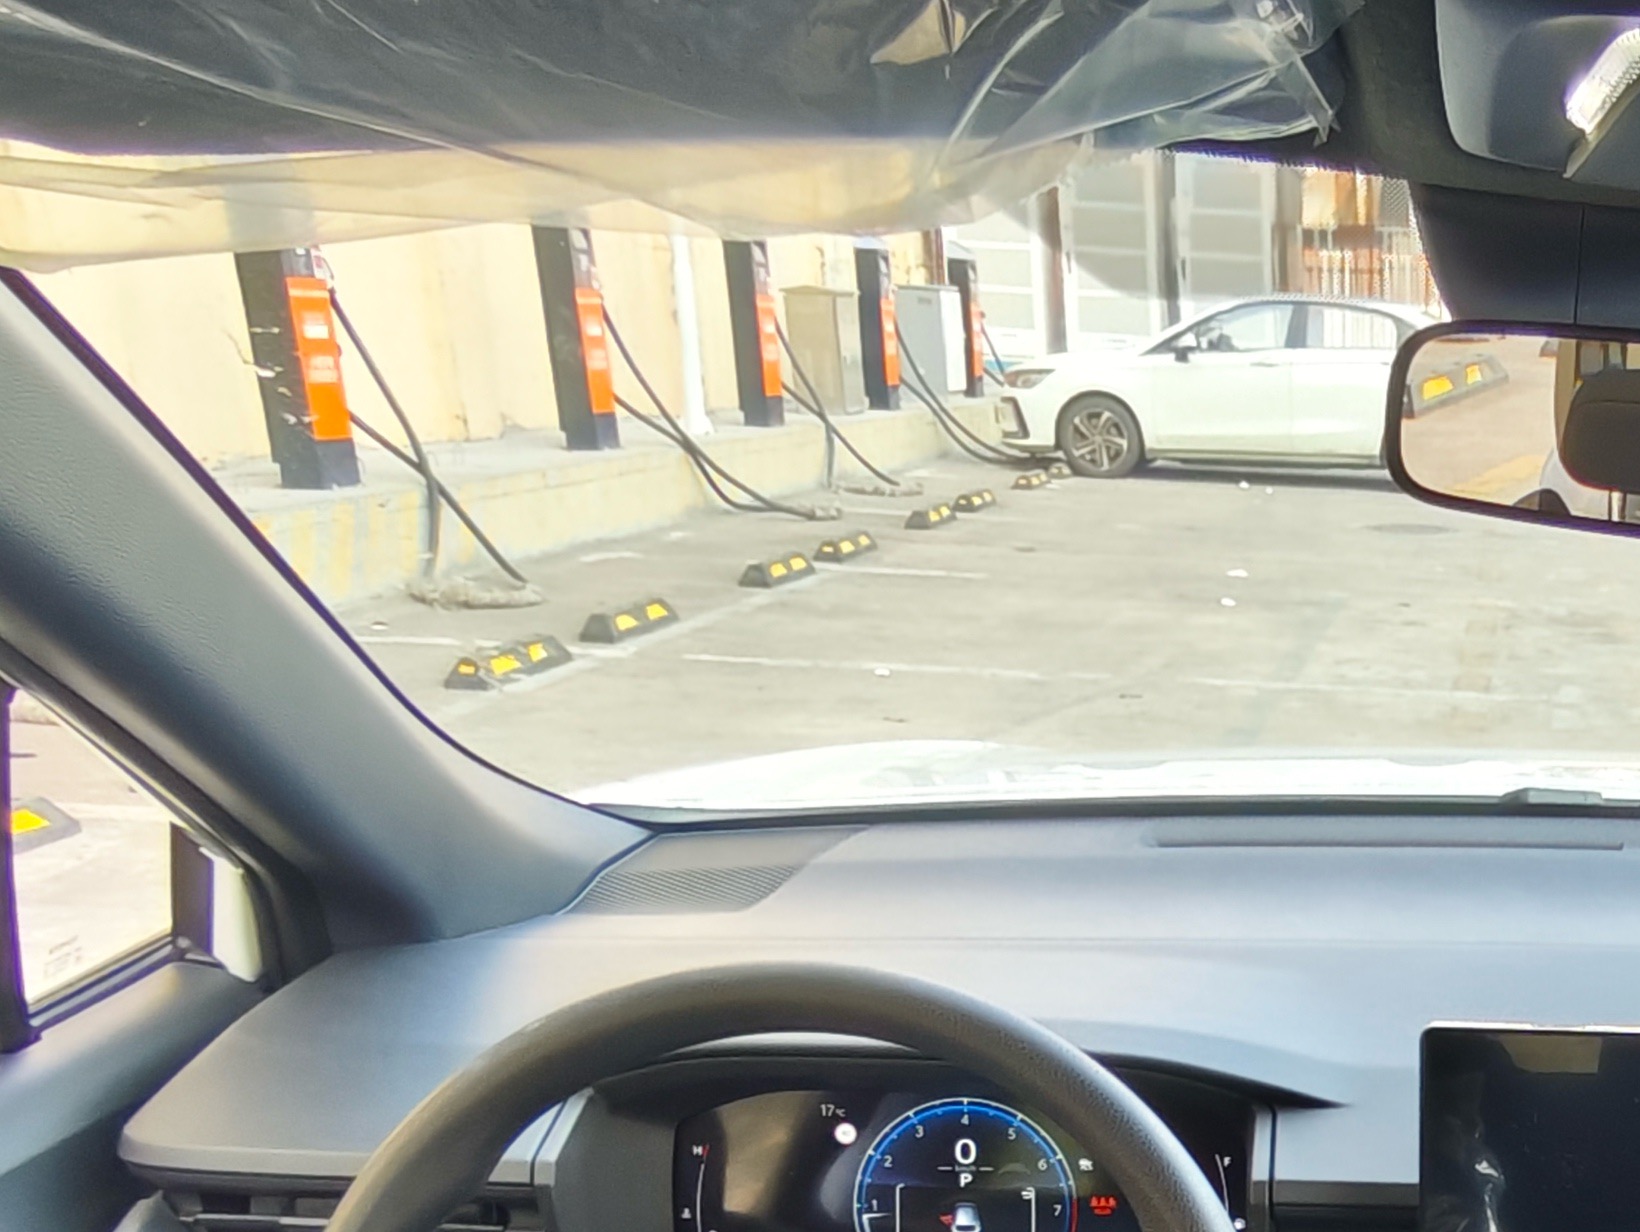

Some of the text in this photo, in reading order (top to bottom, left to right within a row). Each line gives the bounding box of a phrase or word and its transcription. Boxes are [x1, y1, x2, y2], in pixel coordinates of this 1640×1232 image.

[960, 1114, 970, 1126] 4
[915, 1125, 925, 1138] 3
[1007, 1126, 1017, 1140] 5
[692, 1145, 703, 1156] H
[954, 1138, 977, 1165] 0
[883, 1155, 893, 1168] 2
[1037, 1158, 1048, 1171] 6
[1223, 1156, 1232, 1168] F
[959, 1173, 973, 1187] P
[871, 1199, 878, 1211] 1
[1053, 1204, 1062, 1217] 7
